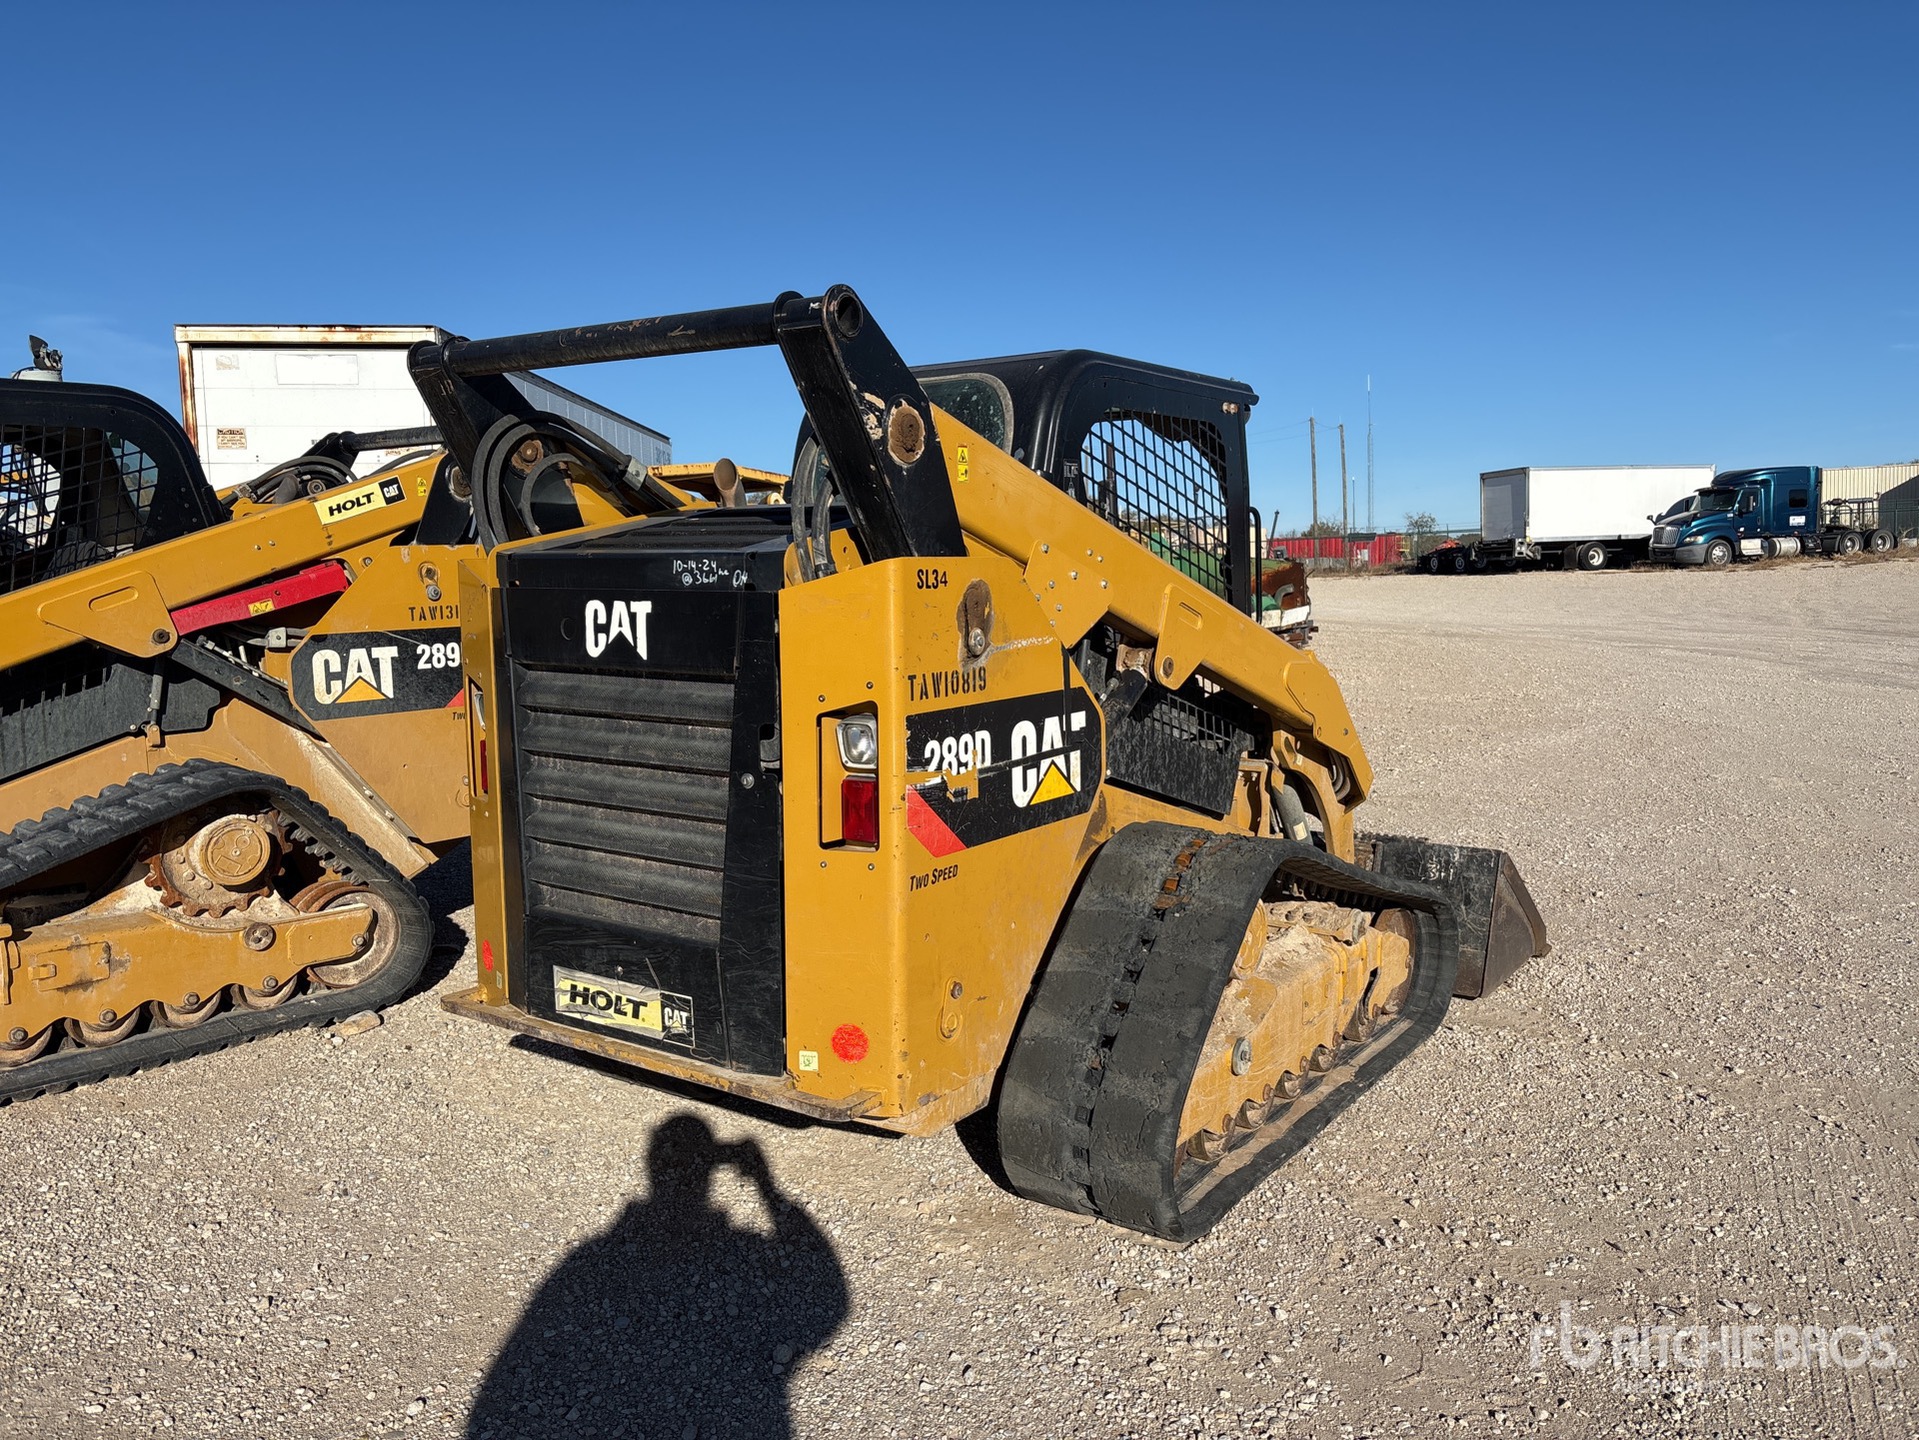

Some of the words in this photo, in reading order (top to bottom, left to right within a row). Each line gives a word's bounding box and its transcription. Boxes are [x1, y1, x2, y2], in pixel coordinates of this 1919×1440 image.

[328, 492, 375, 517] HOLT
[383, 484, 400, 498] CAT
[916, 568, 948, 590] SL34
[585, 599, 653, 661] CAT
[416, 642, 461, 670] 289
[311, 646, 399, 705] CAT
[924, 729, 992, 786] 289D
[1010, 710, 1087, 809] CAT
[569, 983, 647, 1019] HOLT
[663, 1006, 690, 1033] CAT
